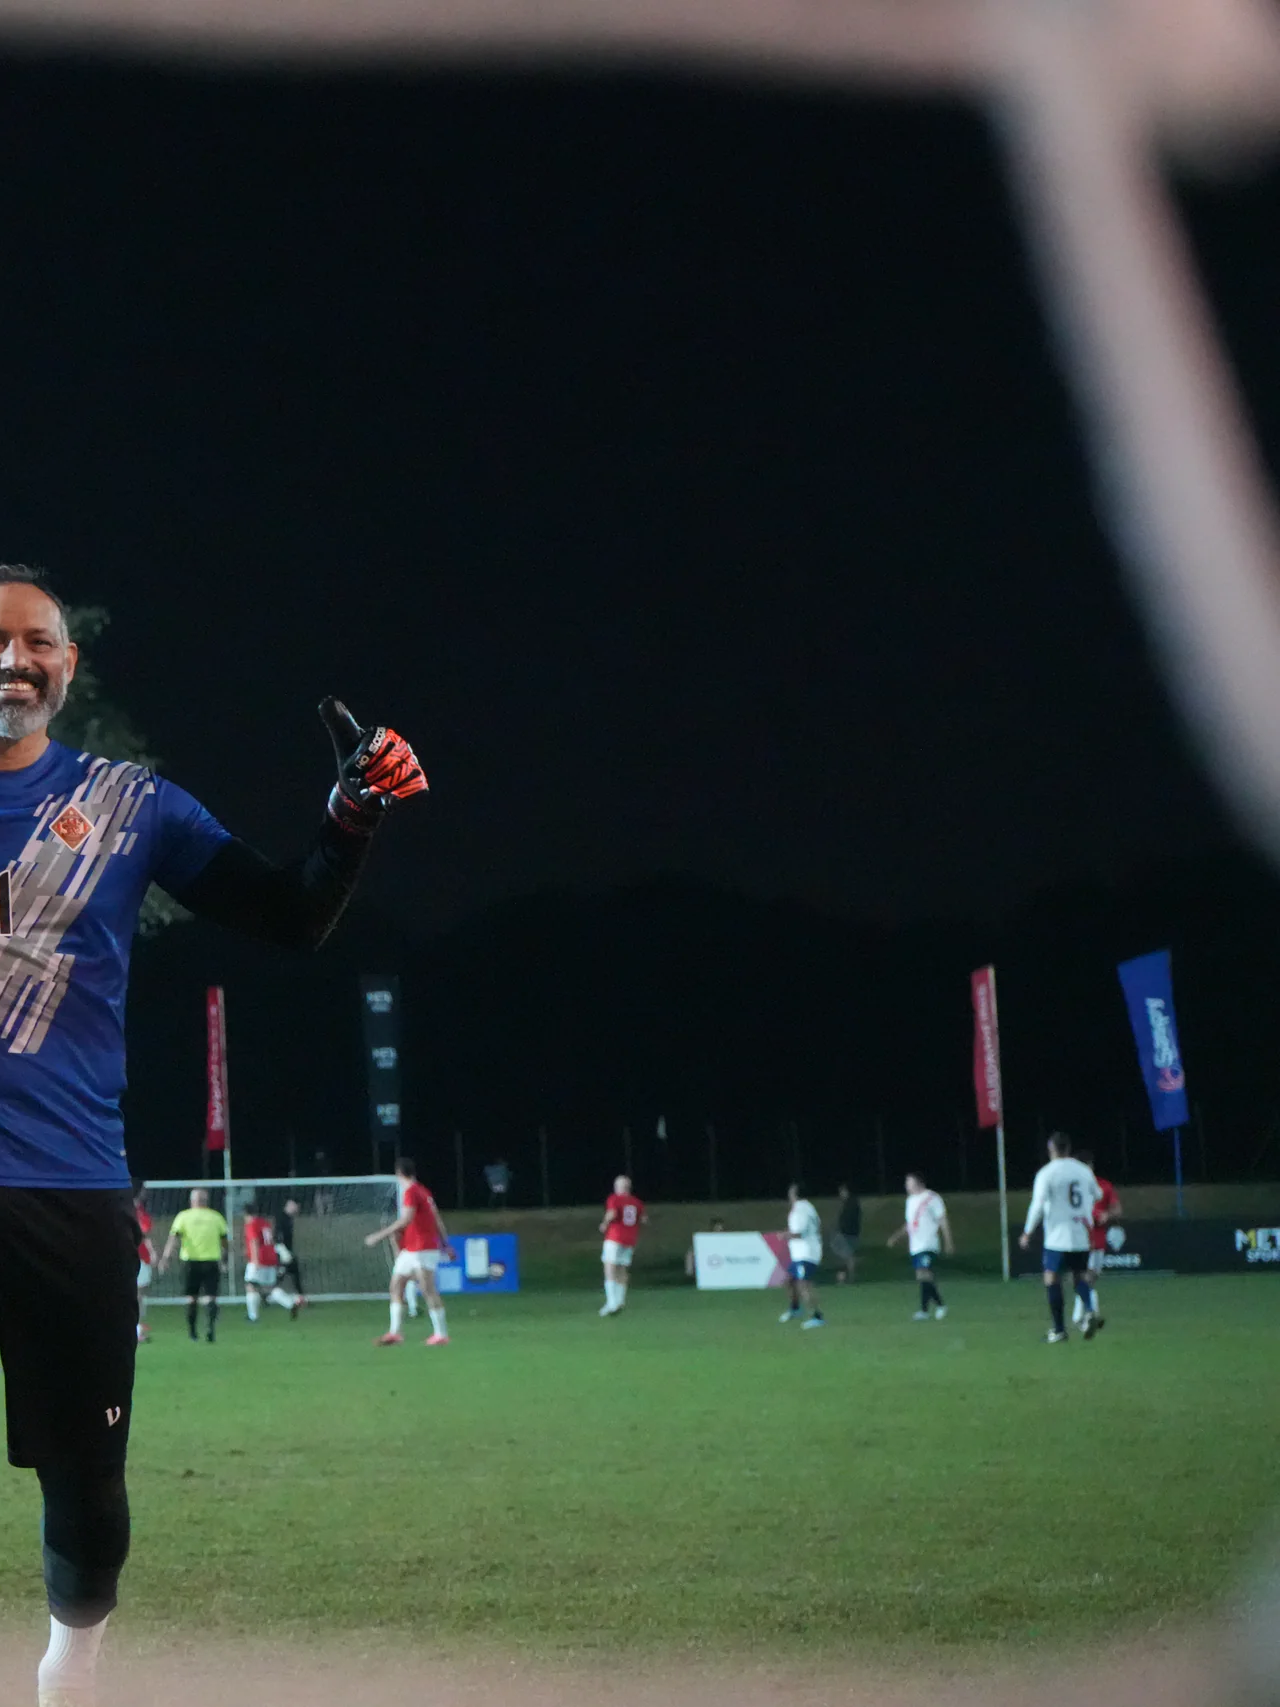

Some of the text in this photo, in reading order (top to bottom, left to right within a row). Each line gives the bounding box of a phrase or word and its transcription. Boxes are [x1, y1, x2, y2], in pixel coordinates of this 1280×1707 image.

[369, 727, 386, 754] SOCC
[1069, 1179, 1082, 1209] 6
[1235, 1225, 1280, 1251] MET
